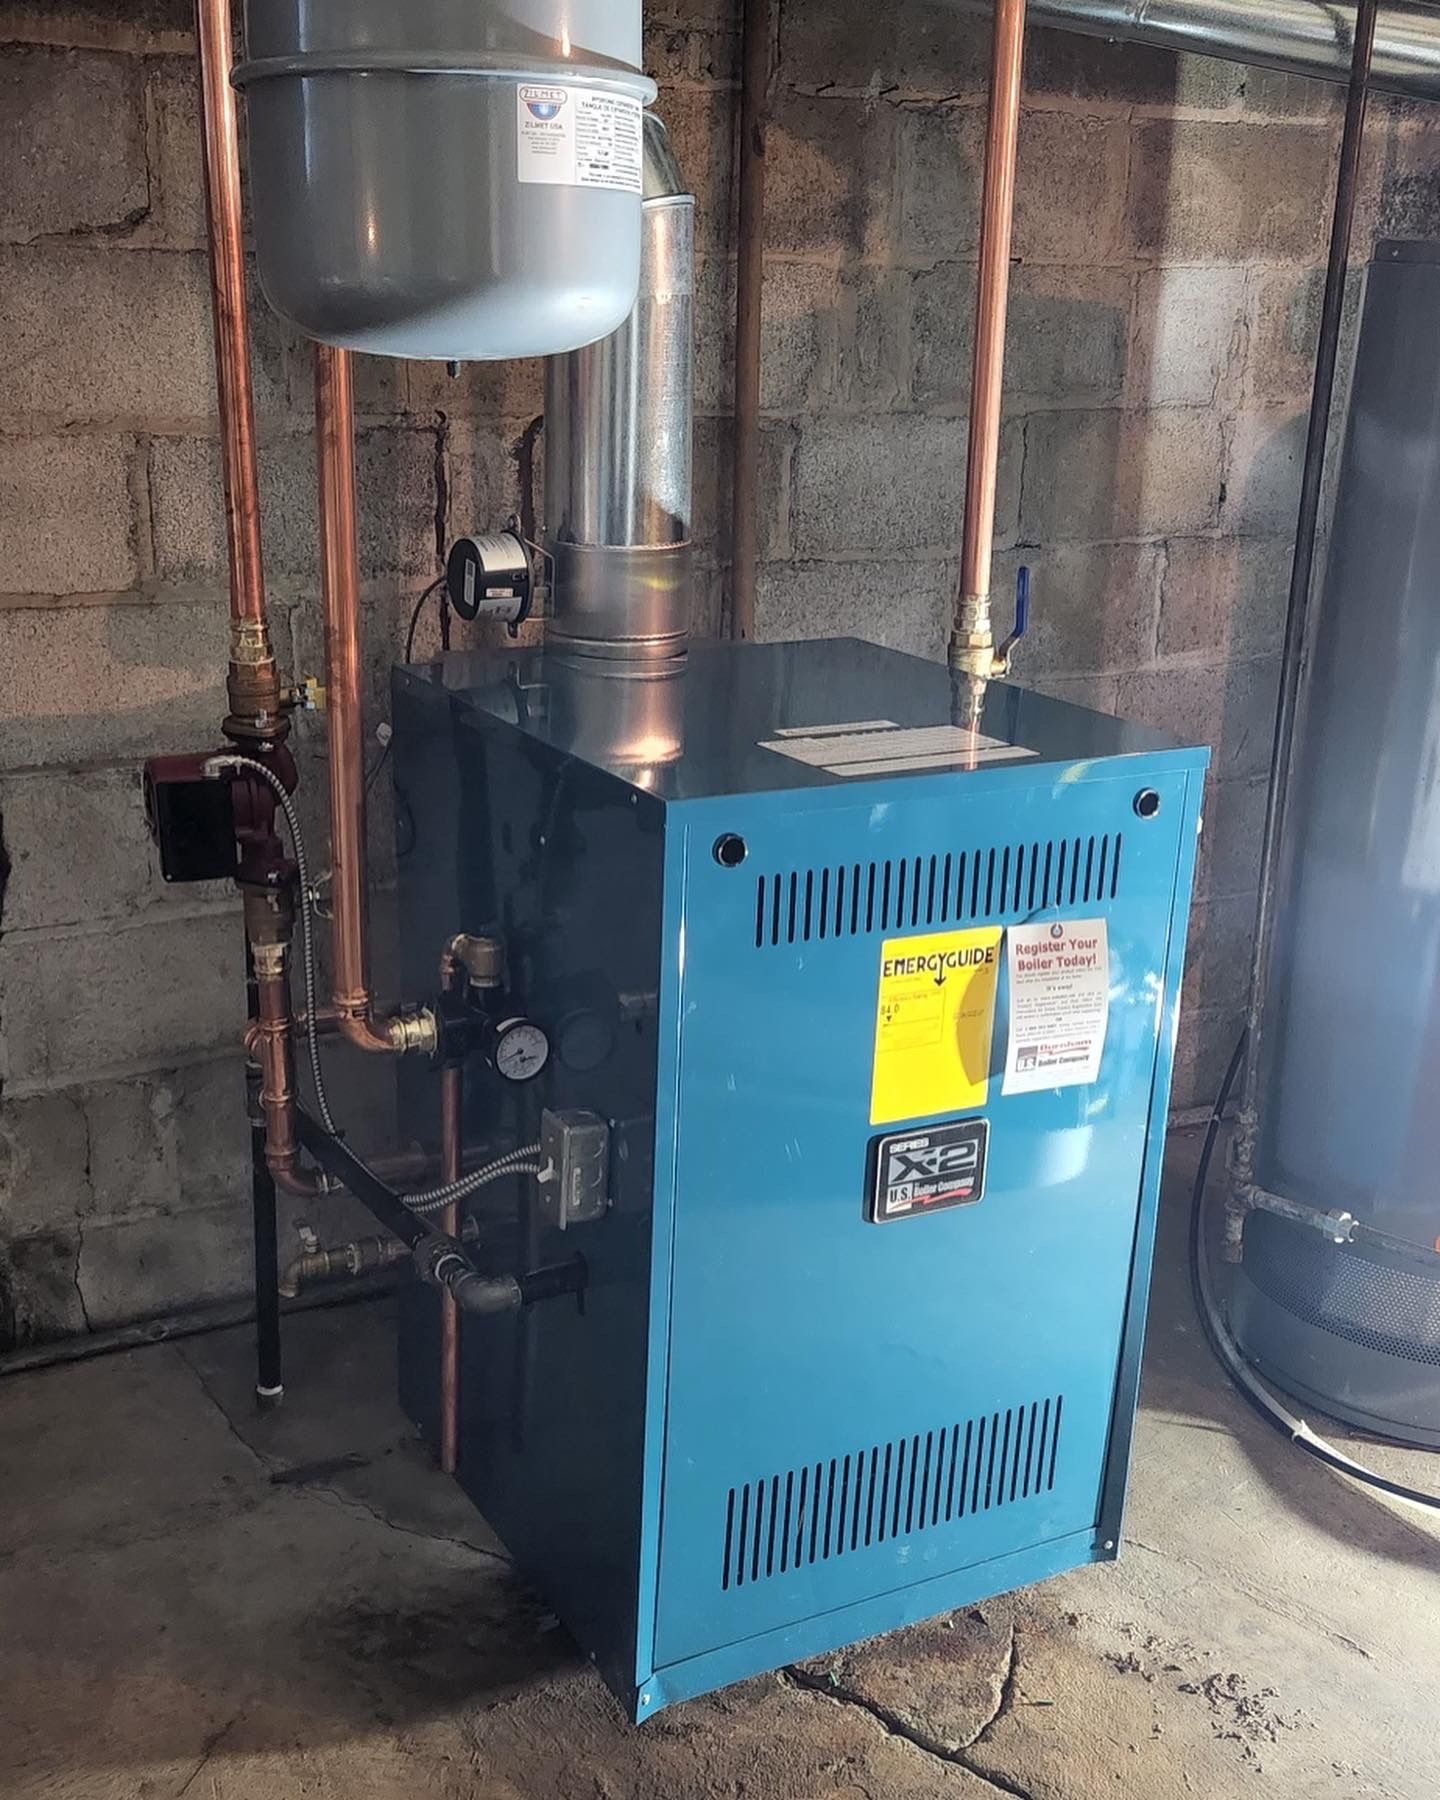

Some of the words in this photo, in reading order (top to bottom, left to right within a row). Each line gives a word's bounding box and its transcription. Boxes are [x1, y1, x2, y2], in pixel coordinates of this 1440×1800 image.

[1015, 941, 1066, 956] Register
[1069, 938, 1097, 950] Your
[1018, 958, 1053, 972] Boiler
[1056, 953, 1096, 968] Today!
